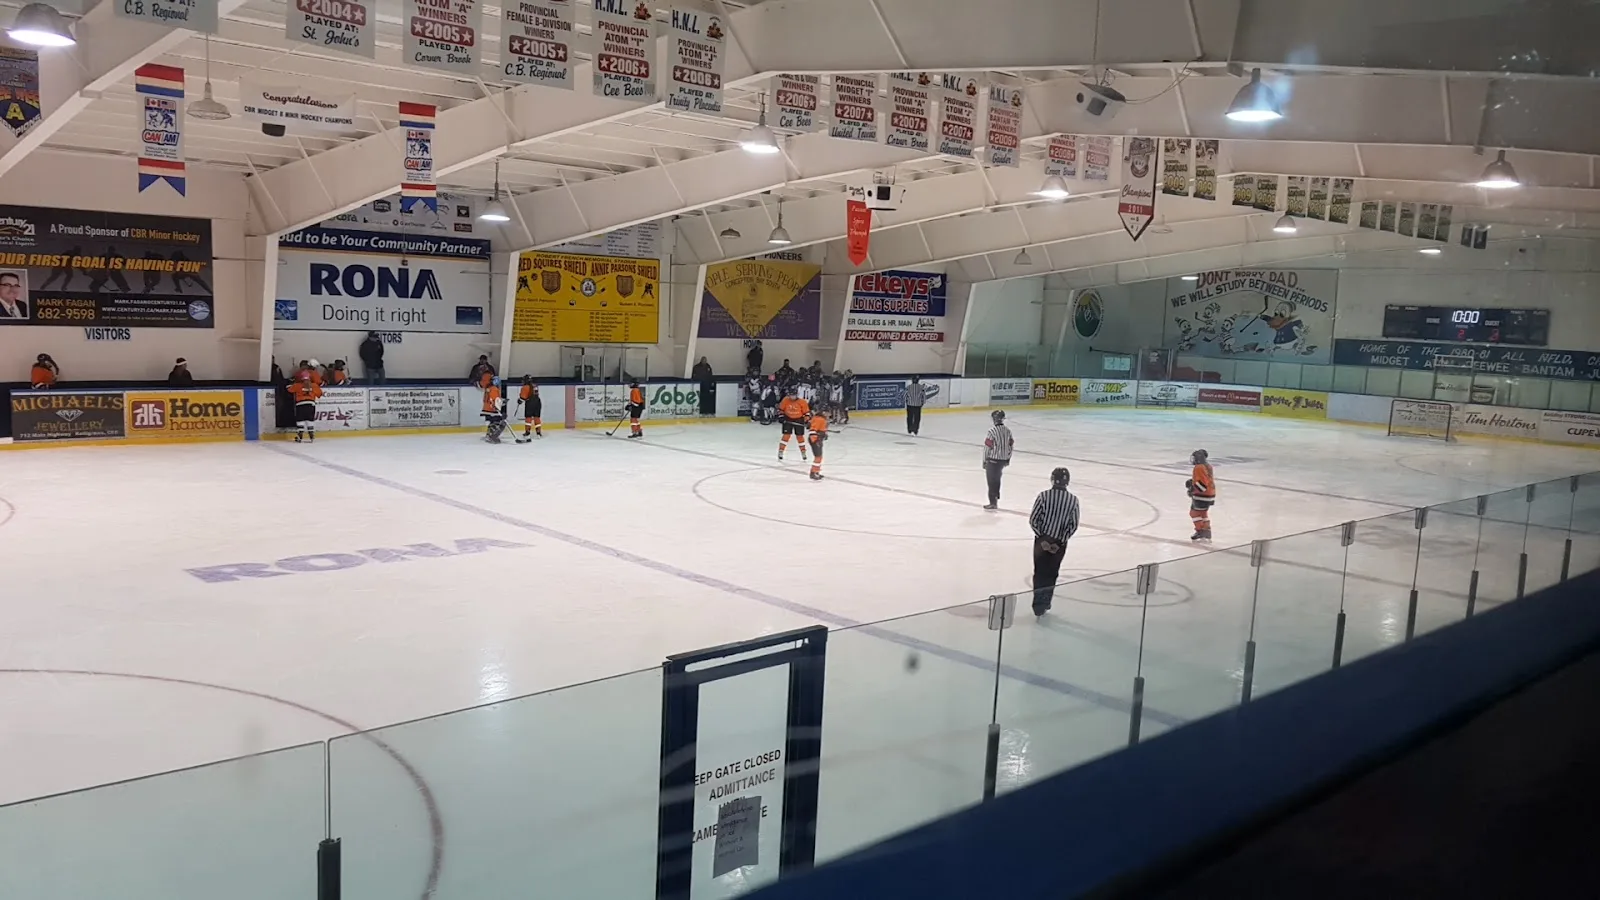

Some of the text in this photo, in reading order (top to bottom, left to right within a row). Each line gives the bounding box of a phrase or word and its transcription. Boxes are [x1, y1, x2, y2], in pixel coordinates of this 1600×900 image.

[124, 0, 188, 21] C.B. Regional
[312, 0, 352, 20] 2004
[418, 6, 467, 24] WINNERS
[520, 3, 559, 18] PROVINCIAL
[506, 10, 572, 32] FEMALE B-DIVISION
[302, 26, 360, 47] St. John's
[424, 22, 460, 42] 2005
[524, 26, 555, 40] WINNERS
[598, 20, 649, 38] PROVINCIAL
[604, 34, 629, 44] ATOM
[522, 40, 556, 58] 2005
[604, 43, 644, 58] WINNERS
[678, 47, 700, 58] ATOM
[610, 56, 639, 75] 2006
[682, 56, 712, 70] WINNERS
[505, 63, 567, 80] C.B. Regional
[683, 69, 712, 86] 2006
[782, 80, 814, 92] WINNERS
[836, 76, 874, 88] PROVINCIAL
[836, 84, 863, 96] MIDGET
[892, 86, 928, 99] PROVINCIAL
[262, 92, 338, 108] Congratulations
[669, 94, 690, 110] Trinity
[839, 94, 871, 106] WINNERS
[894, 96, 912, 105] ATOM
[258, 108, 278, 116] MIDGET
[844, 106, 866, 120] 2007
[896, 105, 924, 115] WINNERS
[946, 105, 962, 114] ATOM
[900, 116, 920, 129] 2007
[946, 114, 970, 124] WINNERS
[949, 125, 967, 138] 2007
[1122, 184, 1152, 199] Champions
[1128, 204, 1143, 214] 2011
[0, 216, 36, 236] entury 21
[50, 224, 200, 244] A Proud Sponsor of CBR Minor Hockey
[306, 234, 482, 254] to be Your Community Partner
[29, 254, 70, 266] FIRST
[72, 256, 106, 268] GOAL
[109, 258, 123, 270] IS
[125, 260, 174, 272] HAVING
[764, 252, 802, 260] PIONEERS
[519, 258, 657, 280] RED SQUIRES SHIELD ANNIE PARSONS SHIELD
[736, 264, 772, 278] SERVING
[310, 263, 442, 300] RONA
[854, 274, 928, 299] ickeys
[1196, 271, 1232, 290] DONT
[1171, 278, 1329, 313] WE WILL STUDY BETWEEN PERIODS
[66, 300, 96, 308] FAGAN
[852, 298, 928, 313] LDING SUPPLIES
[38, 308, 95, 320] 682-9598
[322, 304, 426, 326] Doing it right
[1452, 310, 1480, 324] 10:00
[84, 328, 130, 340] VISITORS
[726, 323, 777, 337] WE SERVE
[848, 331, 876, 340] LOCALLY
[877, 332, 900, 340] OWNED
[908, 332, 939, 341] OPERATED
[1360, 344, 1388, 354] HOME
[1397, 345, 1411, 354] OF
[1421, 347, 1441, 355] THE
[1451, 348, 1490, 358] 1980-81
[1502, 352, 1525, 361] ALL
[1370, 356, 1574, 377] MIDGET BANTAM
[1048, 382, 1078, 393] Home
[1086, 382, 1128, 393] SUBWAY
[650, 385, 700, 406] Sobey
[1109, 394, 1133, 403] fresh.
[1264, 395, 1292, 408] Booster
[13, 396, 122, 411] MICHAEL'S
[170, 398, 240, 417] Home
[34, 420, 104, 432] JEWELLERY
[170, 418, 241, 431] hardware
[1466, 412, 1487, 424] Tim
[1489, 413, 1537, 430] Hortons
[1567, 427, 1594, 437] CUPE
[183, 537, 535, 583] RONA
[694, 750, 781, 786] EEP GATE CLOSED
[709, 768, 776, 801] ADMITTANCE
